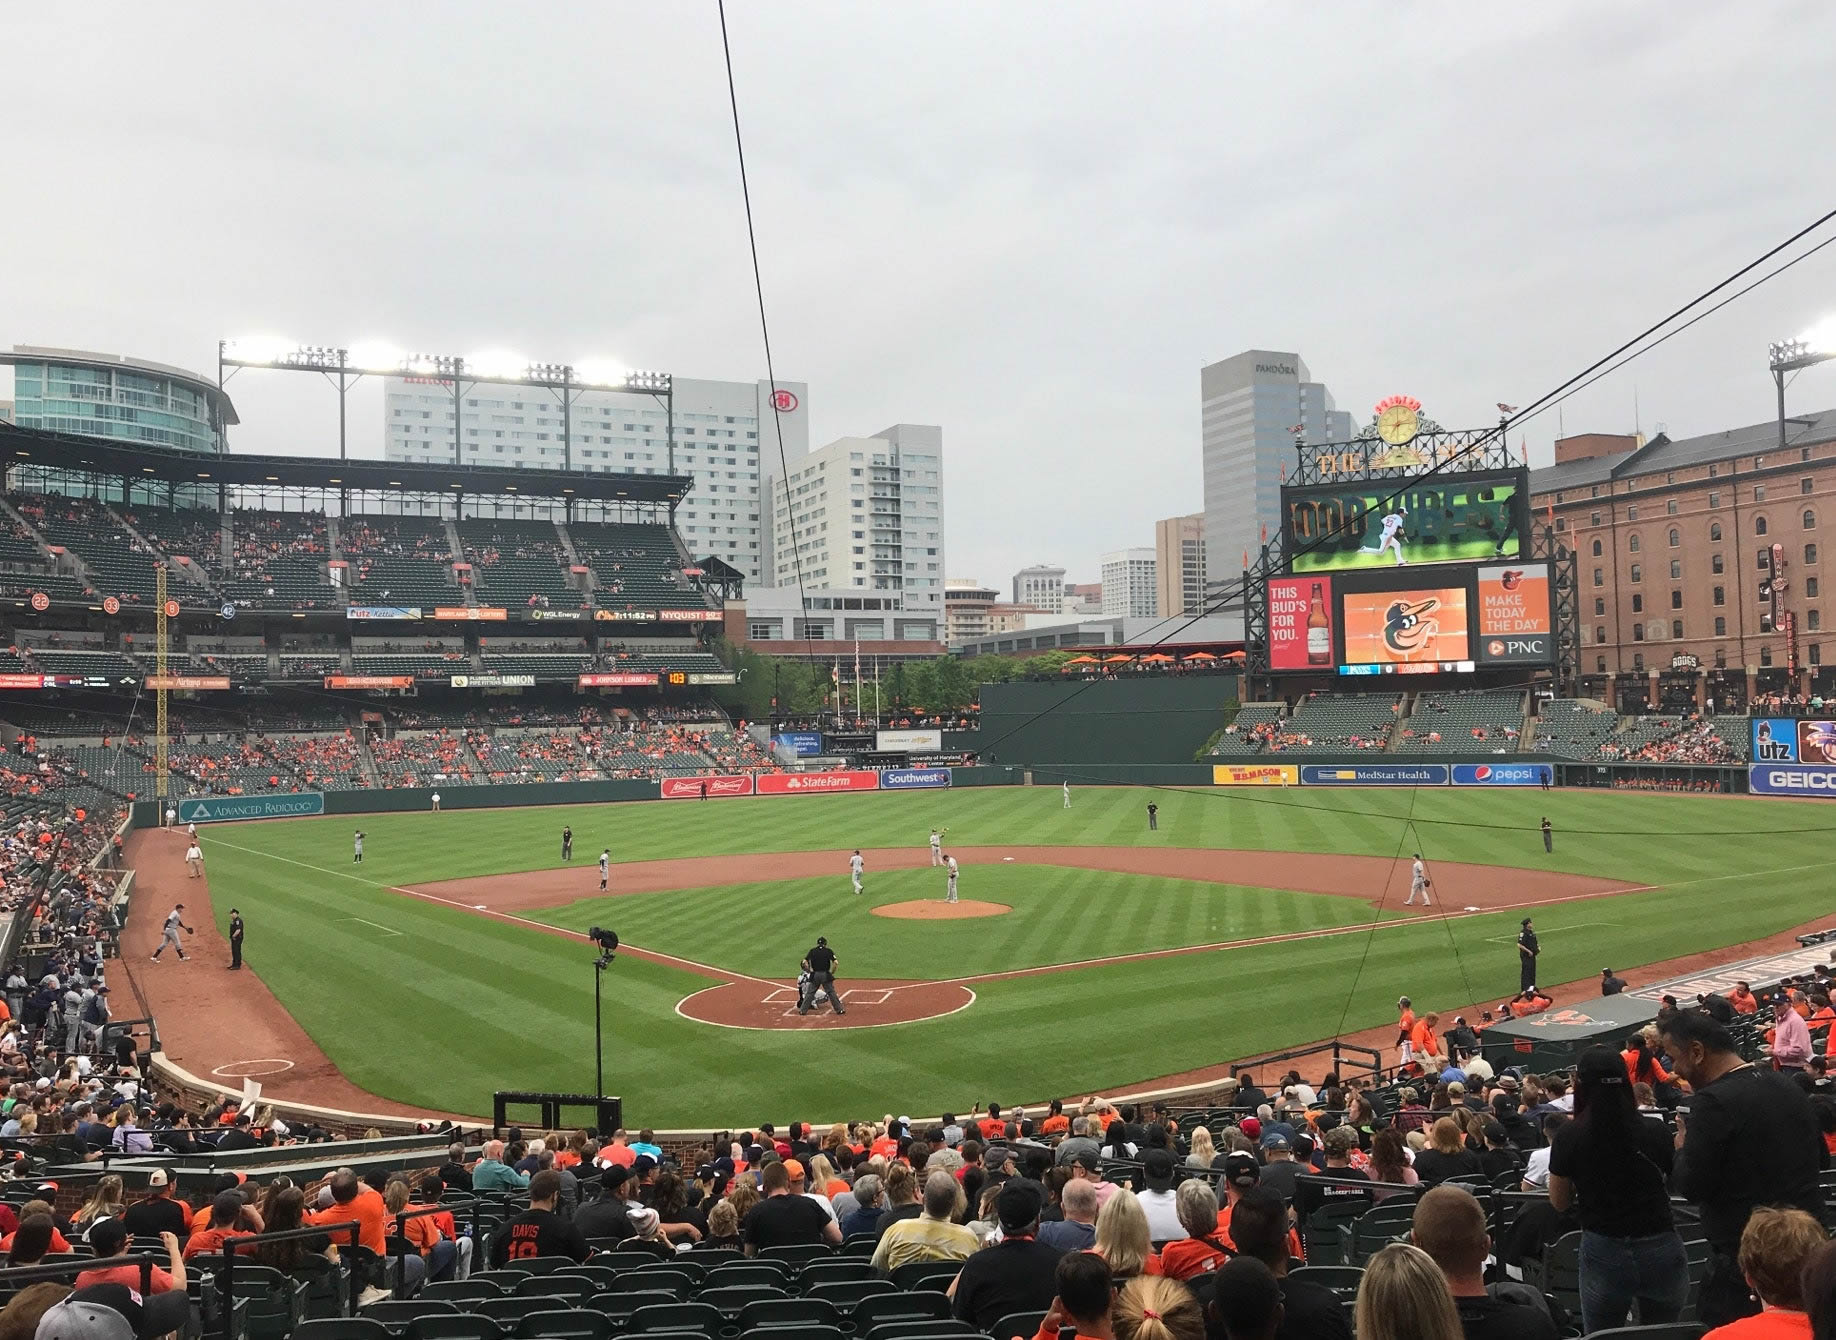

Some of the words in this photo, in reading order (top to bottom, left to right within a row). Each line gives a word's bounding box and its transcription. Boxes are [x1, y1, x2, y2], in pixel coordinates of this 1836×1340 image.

[1316, 453, 1364, 475] THE
[1271, 587, 1297, 599] THIS
[34, 598, 47, 606] 22
[106, 601, 117, 610] 33
[1485, 594, 1522, 606] MAKE
[169, 605, 175, 613] 8
[223, 608, 234, 616] 42
[1271, 600, 1307, 613] BUD'S
[1485, 607, 1526, 619] TODAY
[1272, 615, 1295, 627] FOR
[1486, 620, 1511, 631] THE
[1272, 629, 1299, 640] YOU.
[1507, 640, 1543, 654] PNC
[502, 675, 535, 684] UNION
[596, 676, 624, 684] JOHNSON
[888, 773, 938, 783] Southwest
[1357, 770, 1396, 779] MedStar
[1398, 770, 1431, 779] Health
[1495, 768, 1532, 781] pepsi
[214, 806, 262, 817] ADVANCED
[265, 802, 314, 814] RADIOLOGY
[512, 1224, 539, 1238] DAVIS
